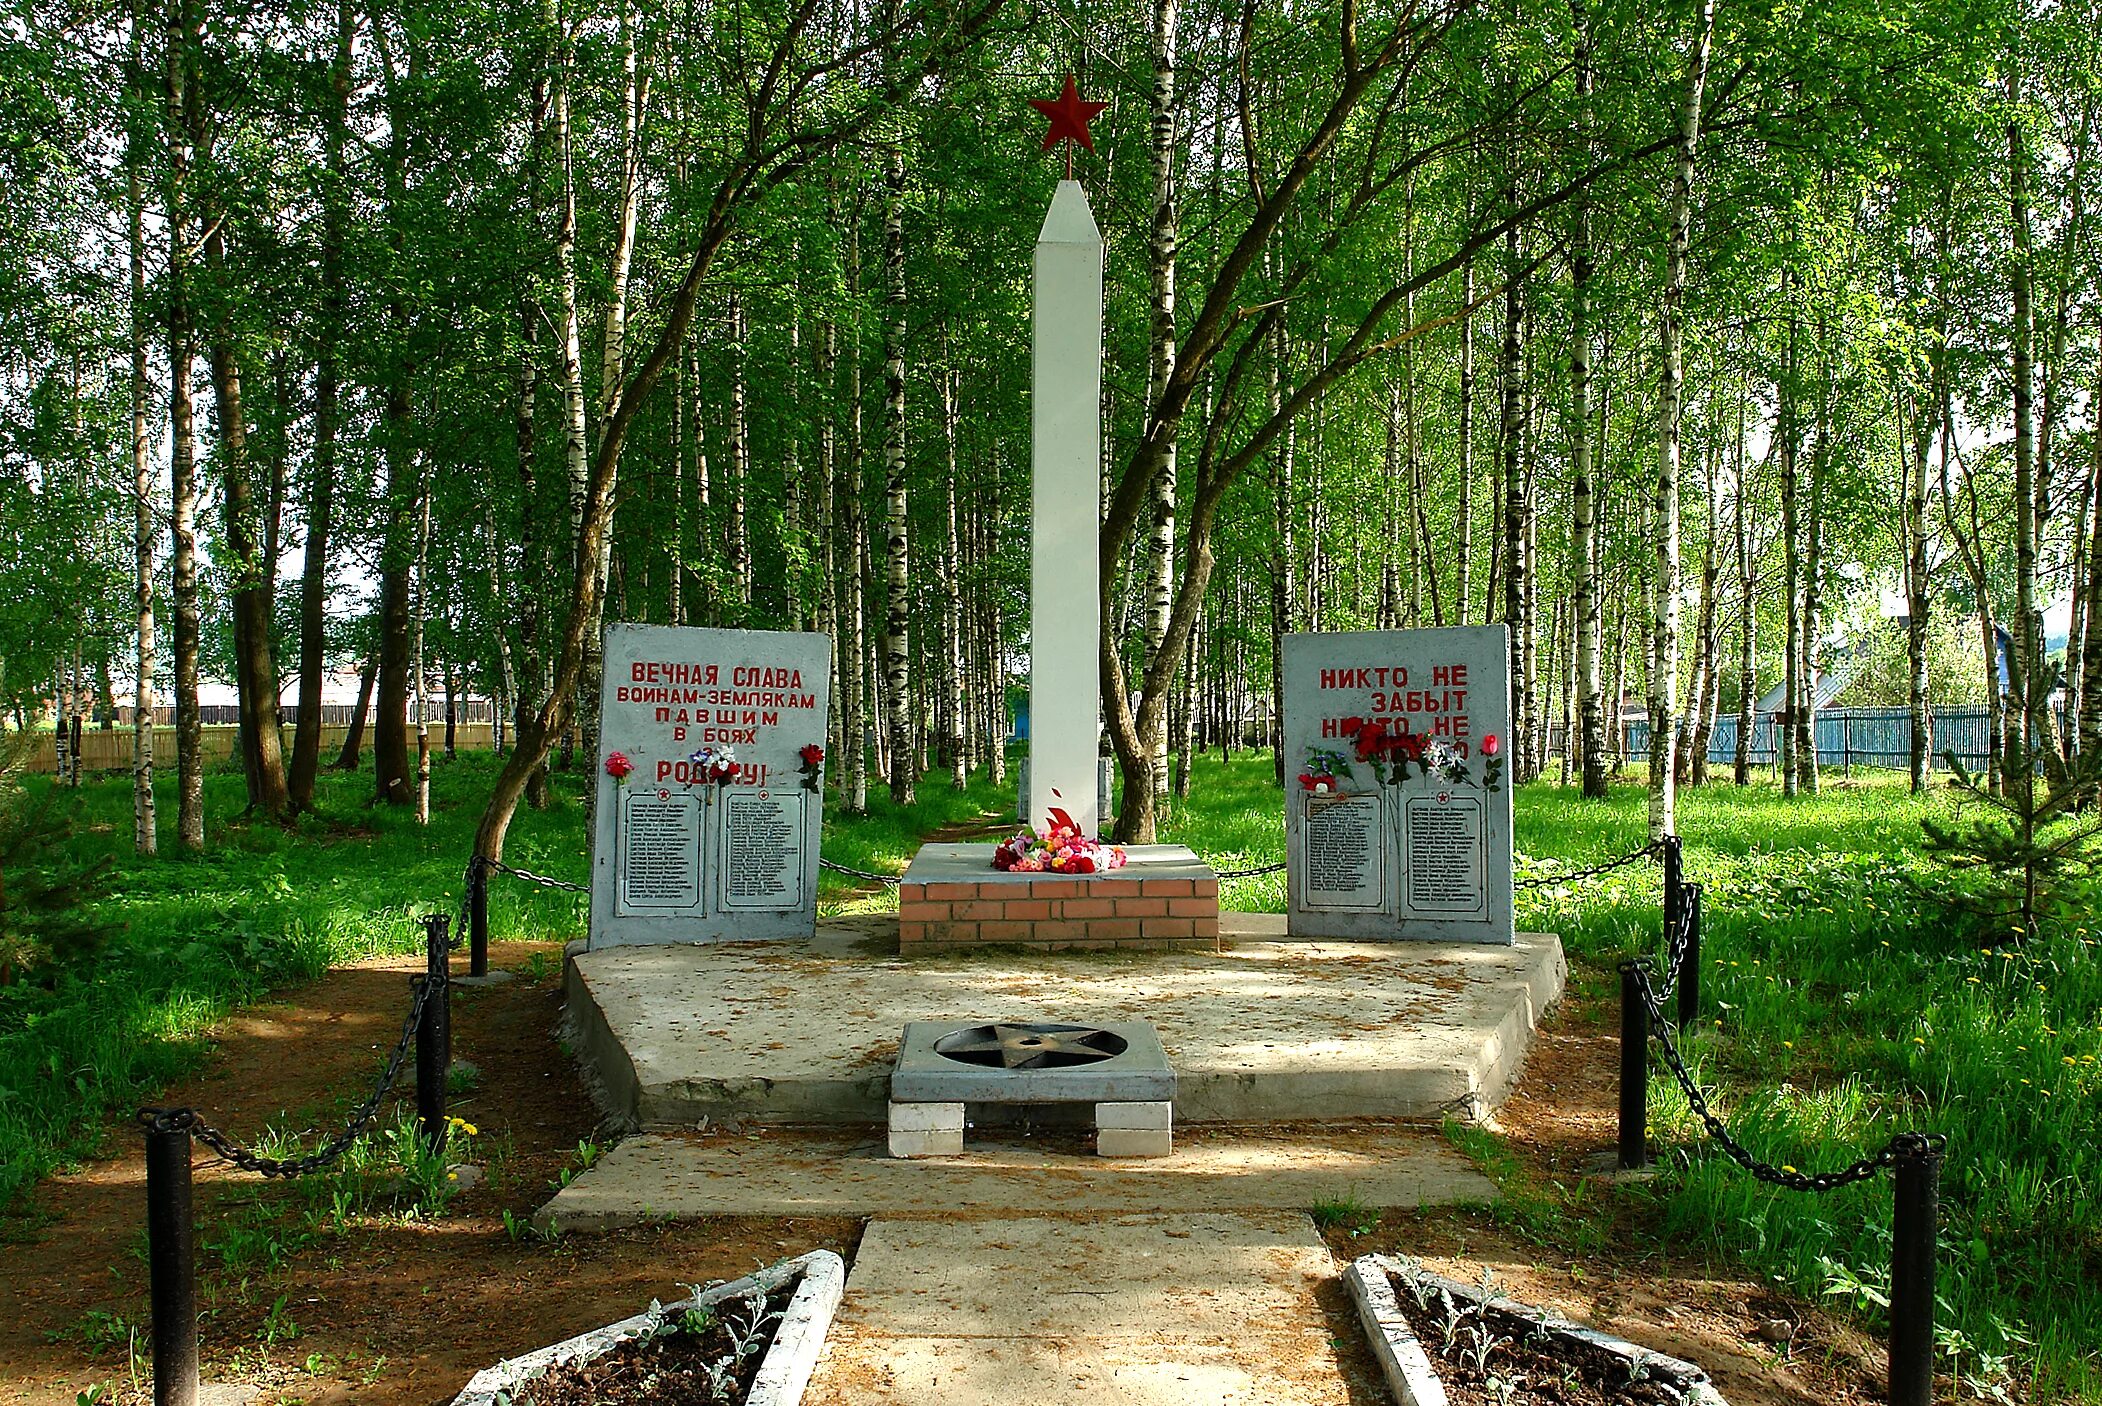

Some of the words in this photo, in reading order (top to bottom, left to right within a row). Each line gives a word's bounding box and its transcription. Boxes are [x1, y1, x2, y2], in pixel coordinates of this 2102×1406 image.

[632, 663, 719, 685] ВЕЧНАЯ
[733, 667, 802, 689] СЛАВА
[1320, 667, 1408, 688] НИКТО
[1433, 665, 1468, 686] НЕ
[617, 687, 815, 708] ВОИНАМ-ЗЕМЛЯКАМ
[1371, 691, 1468, 713] ЗАБЫТ
[656, 708, 778, 726] ПАВШИМ
[1435, 716, 1469, 737] НЕ
[674, 727, 686, 741] В
[704, 728, 756, 744] БОЯХ
[657, 761, 767, 787] РОДУ!
